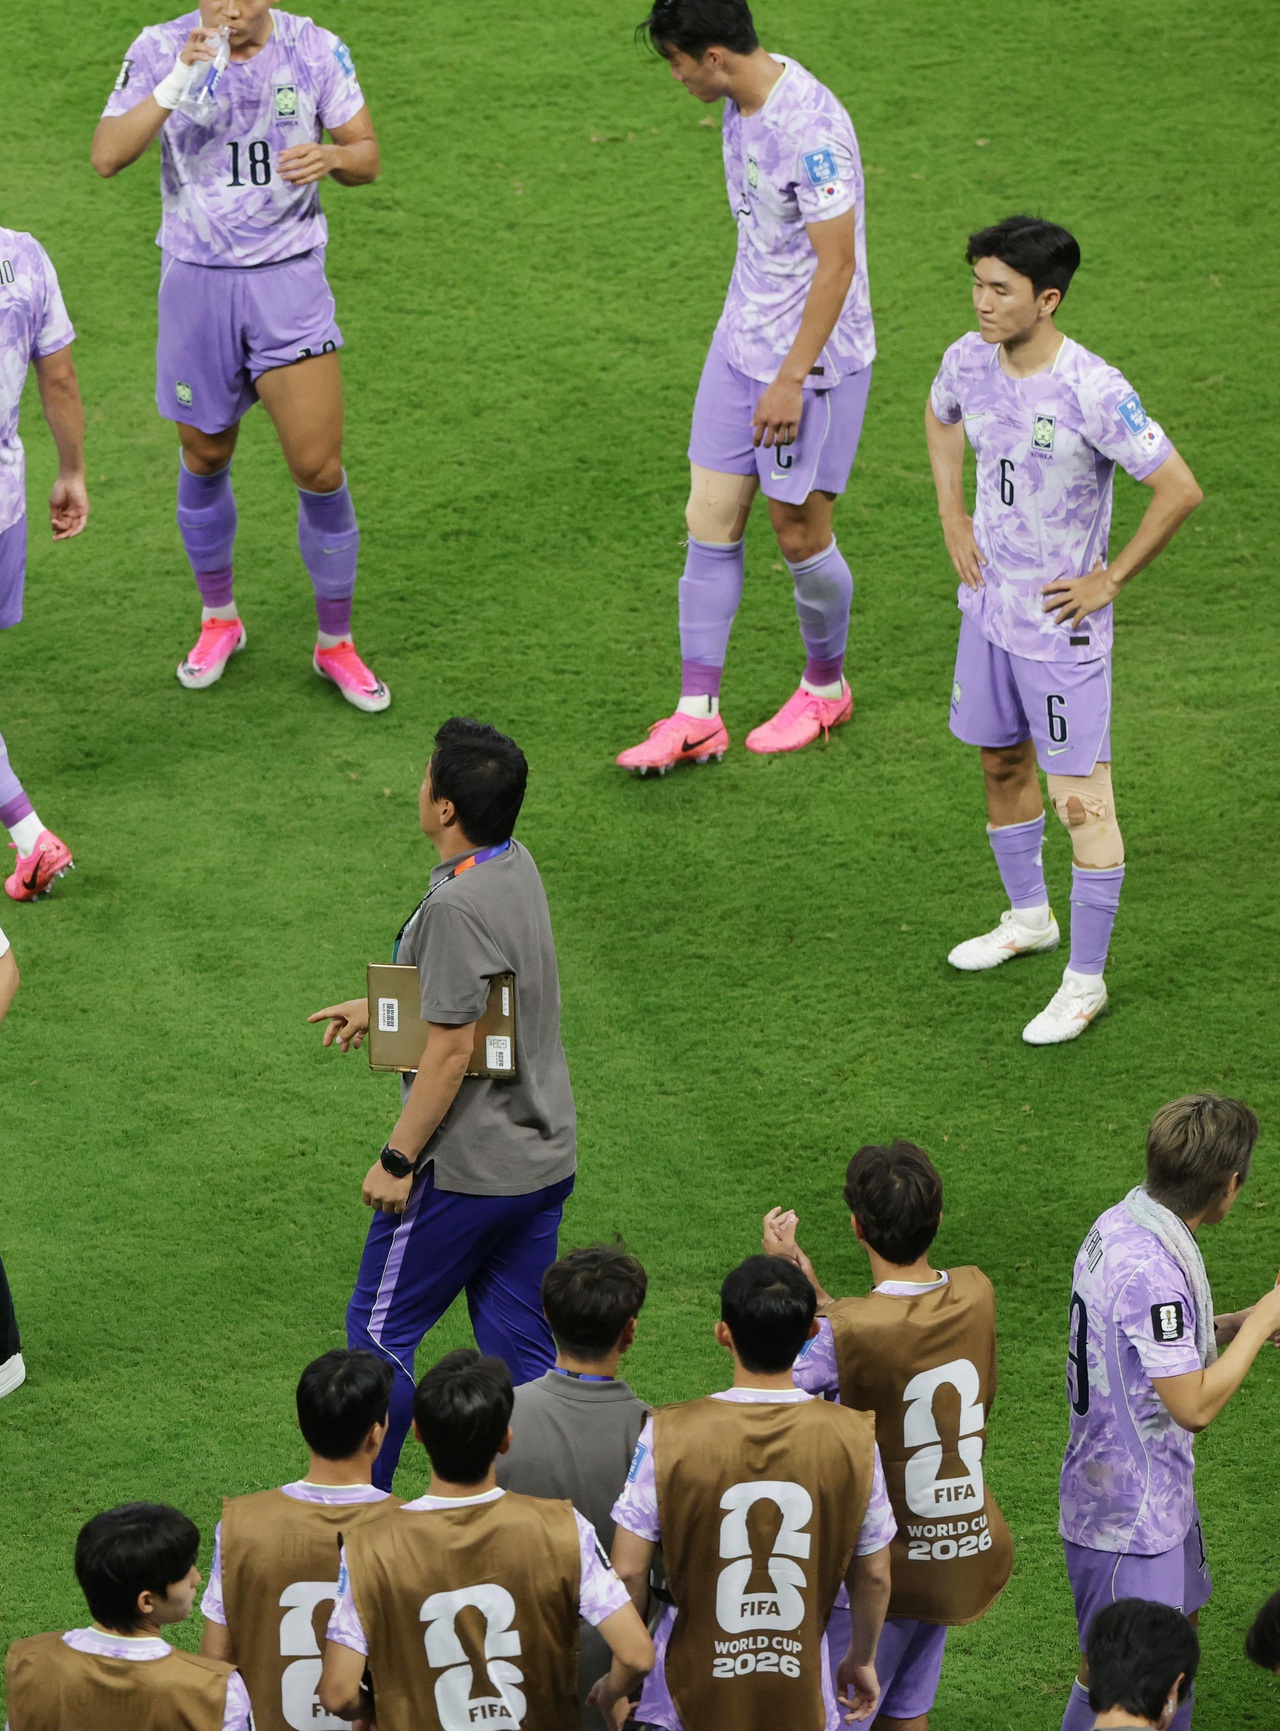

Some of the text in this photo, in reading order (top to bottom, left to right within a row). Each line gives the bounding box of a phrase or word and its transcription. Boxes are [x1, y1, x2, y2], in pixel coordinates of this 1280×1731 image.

[226, 140, 272, 188] 18
[1030, 451, 1054, 461] KOREA
[999, 458, 1015, 507] 6
[1046, 694, 1069, 743] 6
[934, 1483, 976, 1504] FIFA
[907, 1513, 988, 1538] WORLD CU
[907, 1527, 993, 1561] 2026
[740, 1600, 781, 1618] FIFA
[714, 1635, 803, 1655] WORLD CUP
[712, 1651, 801, 1678] 2026
[468, 1703, 513, 1723] FIFA
